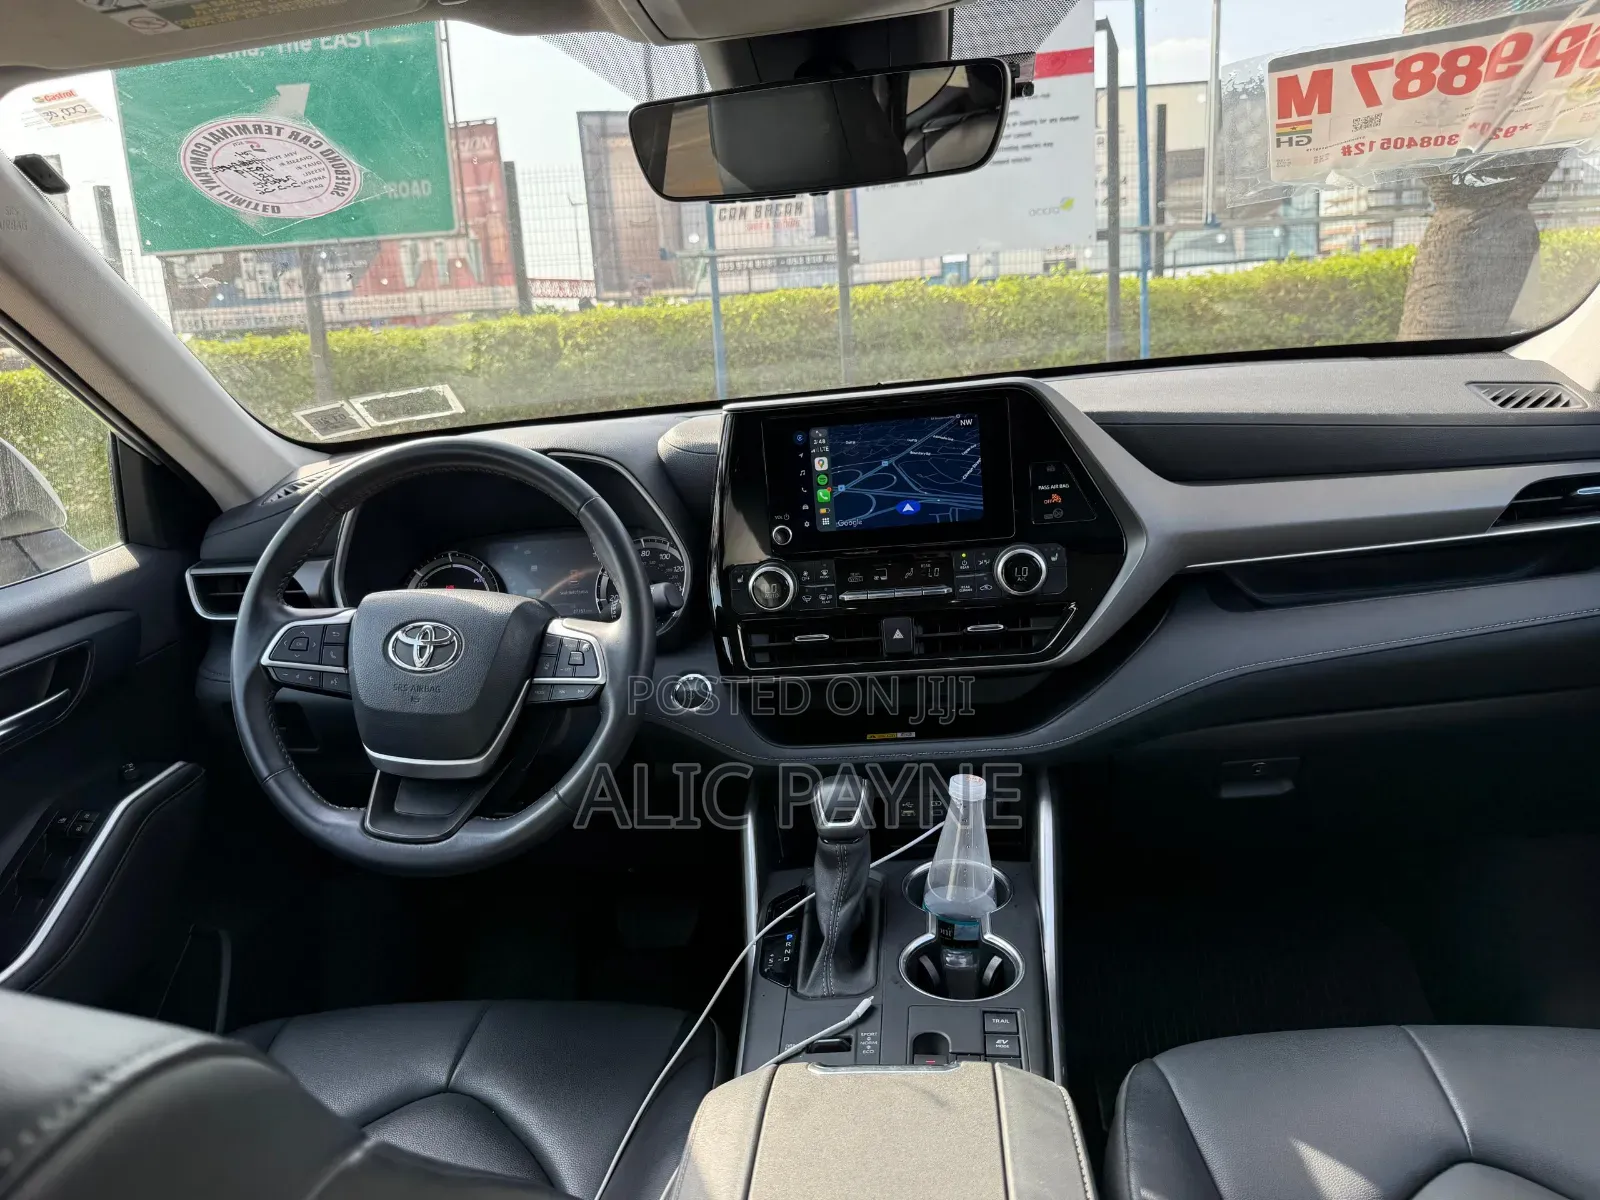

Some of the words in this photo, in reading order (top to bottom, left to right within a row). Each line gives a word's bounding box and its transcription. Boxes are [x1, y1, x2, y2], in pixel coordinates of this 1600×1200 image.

[319, 30, 373, 49] EAST
[44, 90, 75, 102] Castrol
[388, 180, 432, 199] ROAD
[960, 418, 973, 426] NW
[837, 519, 863, 528] Google
[1014, 566, 1029, 577] LO
[392, 684, 408, 692] SRS
[409, 685, 441, 693] AIRBAG
